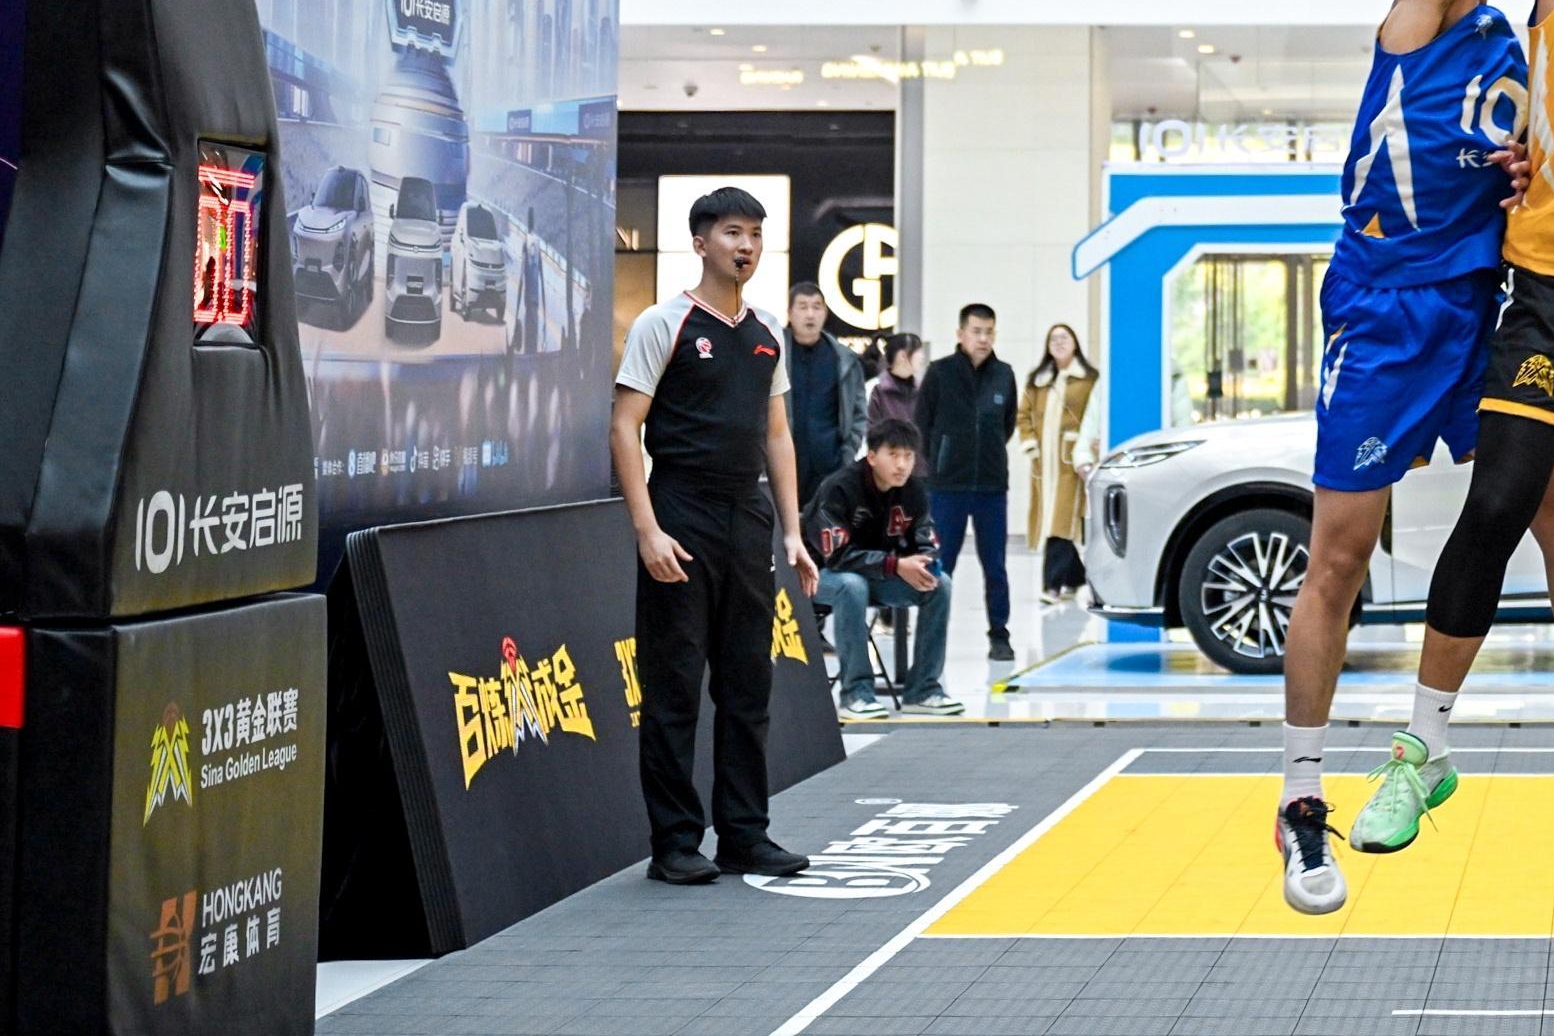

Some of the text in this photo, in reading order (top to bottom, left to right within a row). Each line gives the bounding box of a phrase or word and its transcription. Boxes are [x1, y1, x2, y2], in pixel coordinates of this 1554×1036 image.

[189, 483, 304, 557] 长安启源
[201, 687, 299, 756] 3X3黄金联赛
[200, 743, 297, 789] Sina Golden League
[202, 867, 283, 928] HONGKANG
[198, 907, 282, 975] 宏康体育
